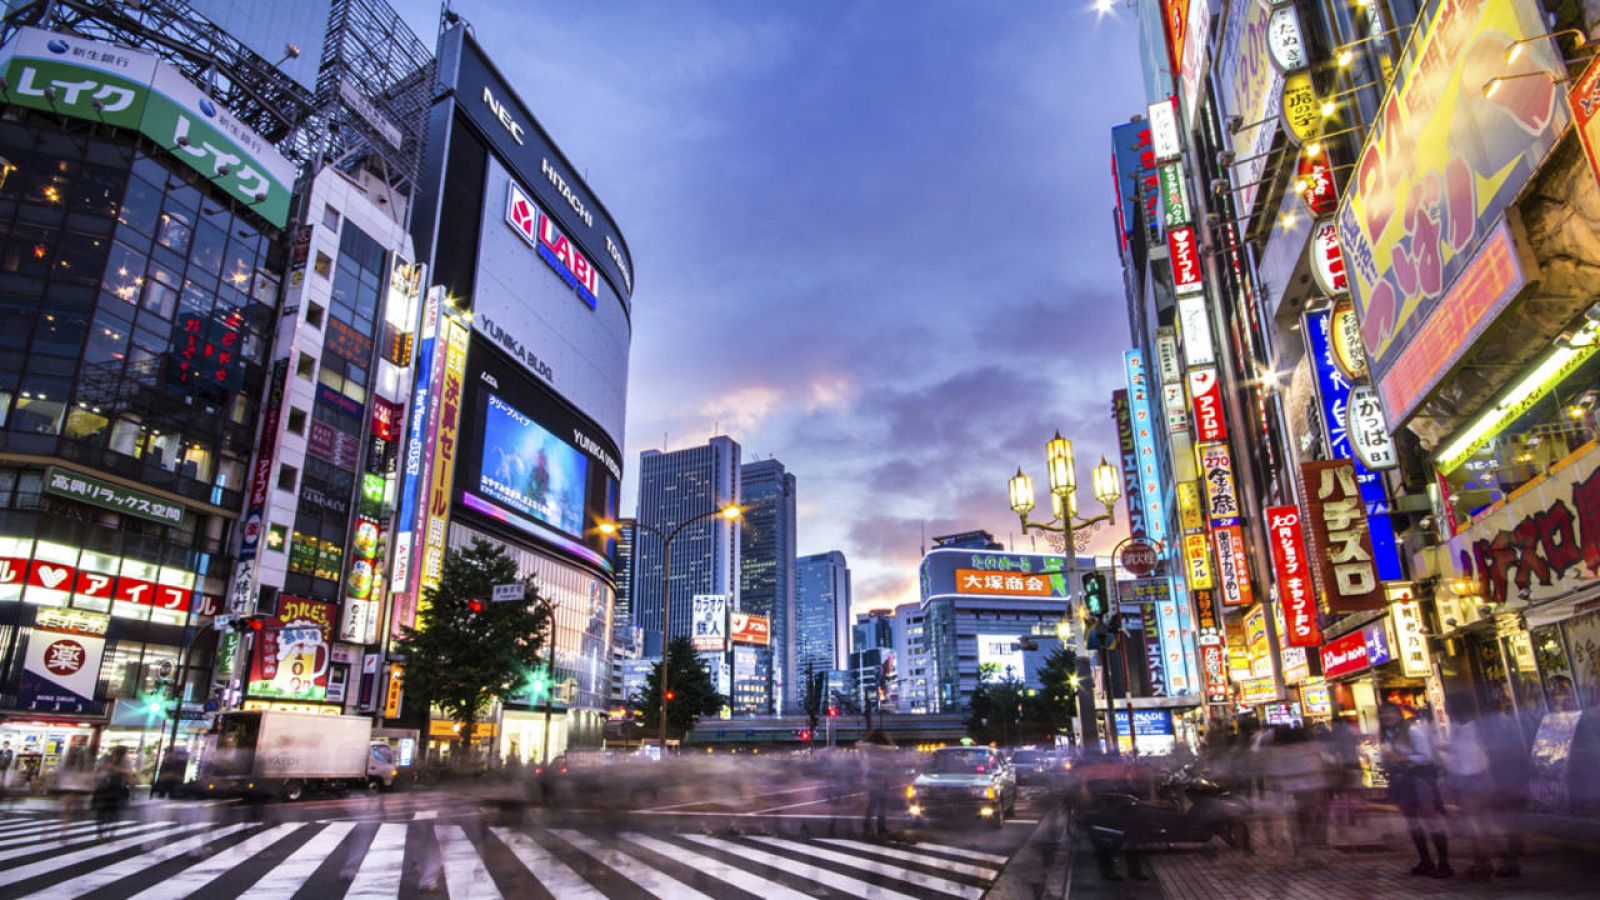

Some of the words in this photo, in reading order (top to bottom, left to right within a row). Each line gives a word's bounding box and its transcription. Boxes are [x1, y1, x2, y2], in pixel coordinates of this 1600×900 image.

[72, 47, 129, 68] 新生銀行
[17, 67, 135, 111] レイク
[484, 86, 525, 145] NEC
[173, 114, 270, 200] レイク
[542, 158, 593, 228] HITACHI
[540, 213, 599, 297] LABI
[1175, 242, 1195, 283] アイフル
[480, 314, 527, 362] YUNIKA
[1200, 395, 1218, 429] アコム
[573, 430, 605, 464] YUNIKA
[1205, 456, 1229, 469] 270
[1371, 451, 1391, 461] B1
[253, 459, 270, 504] アイフル
[1318, 464, 1376, 596] パチスロ
[963, 574, 1044, 591] 大塚商会
[1218, 531, 1238, 600] 東京チカラめし
[695, 596, 722, 612] カラオケ
[705, 612, 713, 620] の
[47, 643, 82, 670] 薬
[1115, 712, 1165, 721] SUNADE
